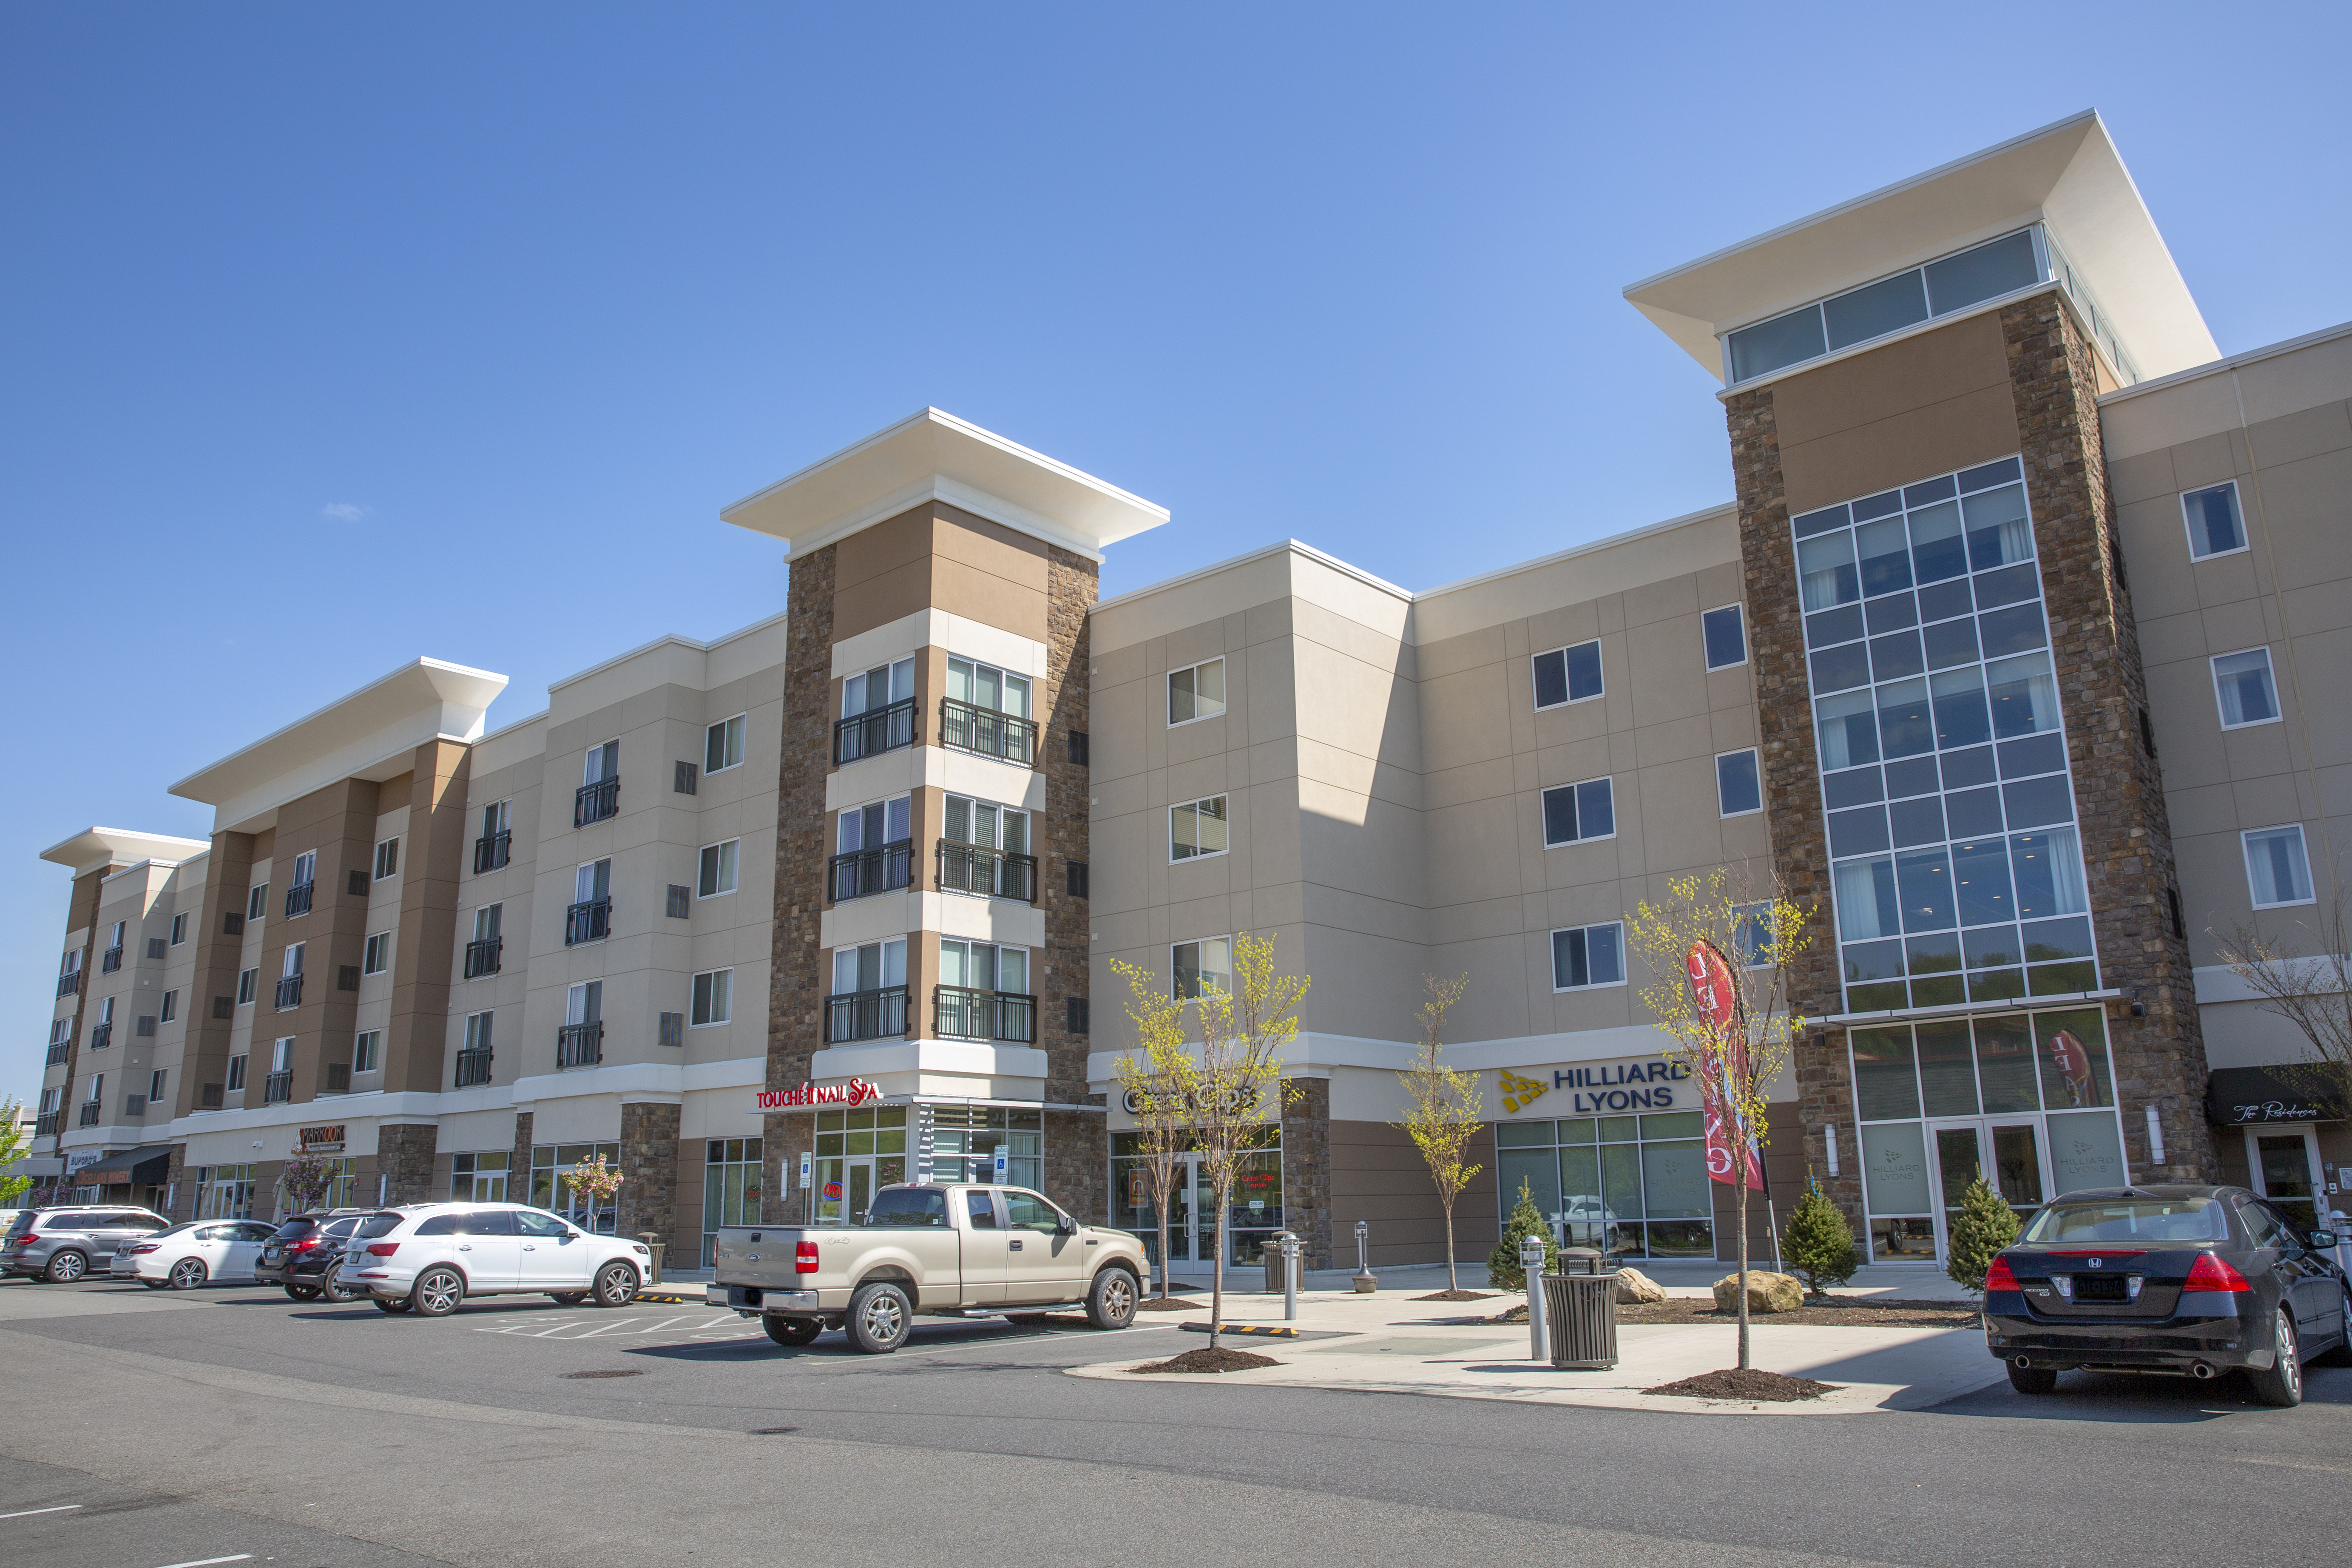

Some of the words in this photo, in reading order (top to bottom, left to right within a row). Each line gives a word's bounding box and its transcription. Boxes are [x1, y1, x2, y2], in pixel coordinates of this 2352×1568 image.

[1554, 1061, 1691, 1088] HILLIARD
[818, 1085, 848, 1103] NAIL
[1574, 1087, 1673, 1112] LYONS
[2234, 1105, 2259, 1121] The
[2261, 1101, 2317, 1120] Residences
[303, 1125, 344, 1143] MARKOOK
[71, 1155, 97, 1165] BUFORD'S
[2060, 1157, 2113, 1165] HILLIARD
[824, 1183, 842, 1198] OPEN
[1651, 1178, 1704, 1187] HILLIARD
